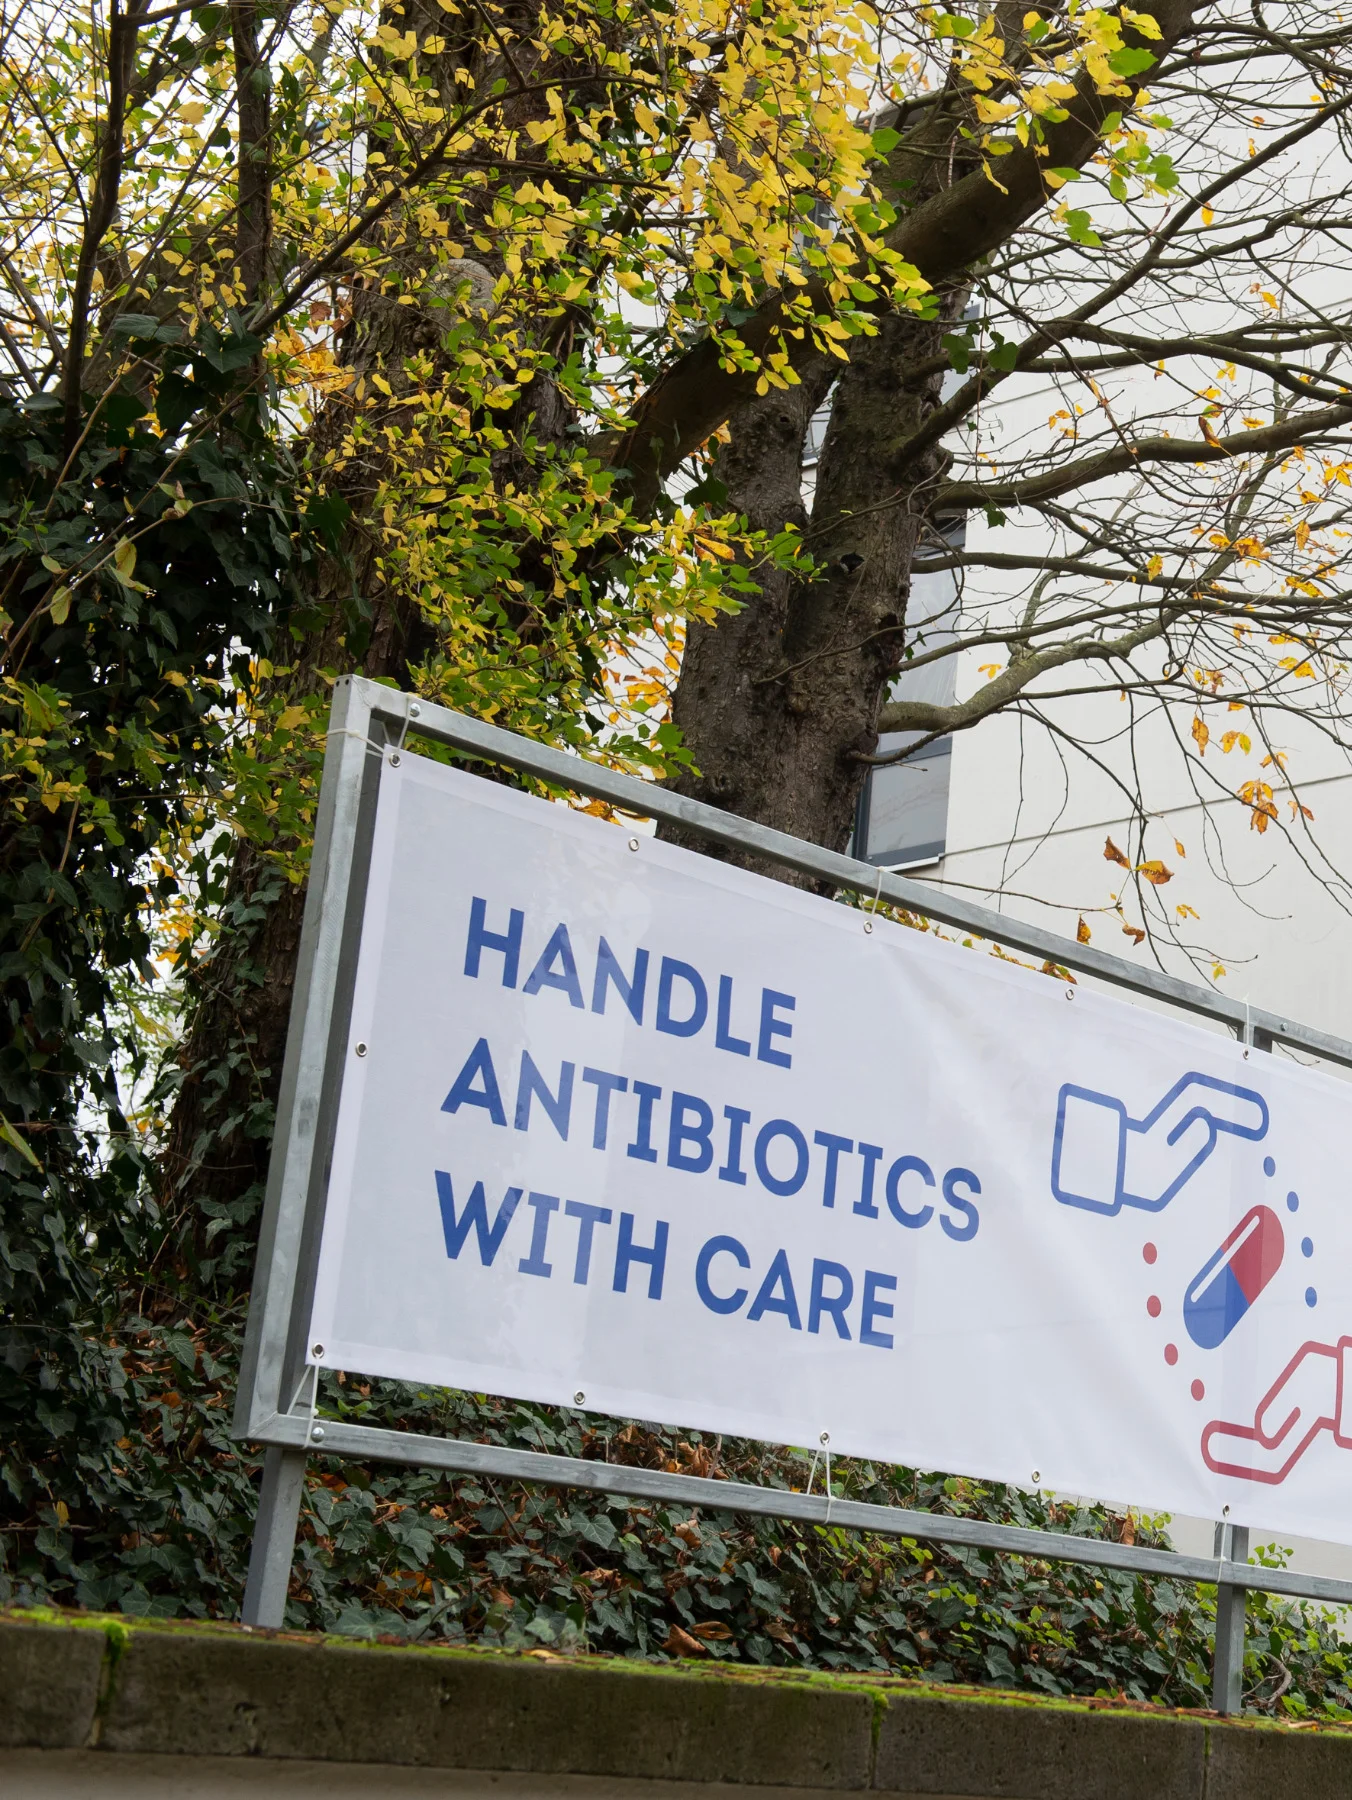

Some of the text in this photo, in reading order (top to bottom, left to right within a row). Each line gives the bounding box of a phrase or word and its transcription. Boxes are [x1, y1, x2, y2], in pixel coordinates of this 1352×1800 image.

[463, 896, 797, 1069] HANDLE
[440, 1037, 982, 1242] ANTIBIOTICS
[434, 1169, 898, 1349] WITH CARE
